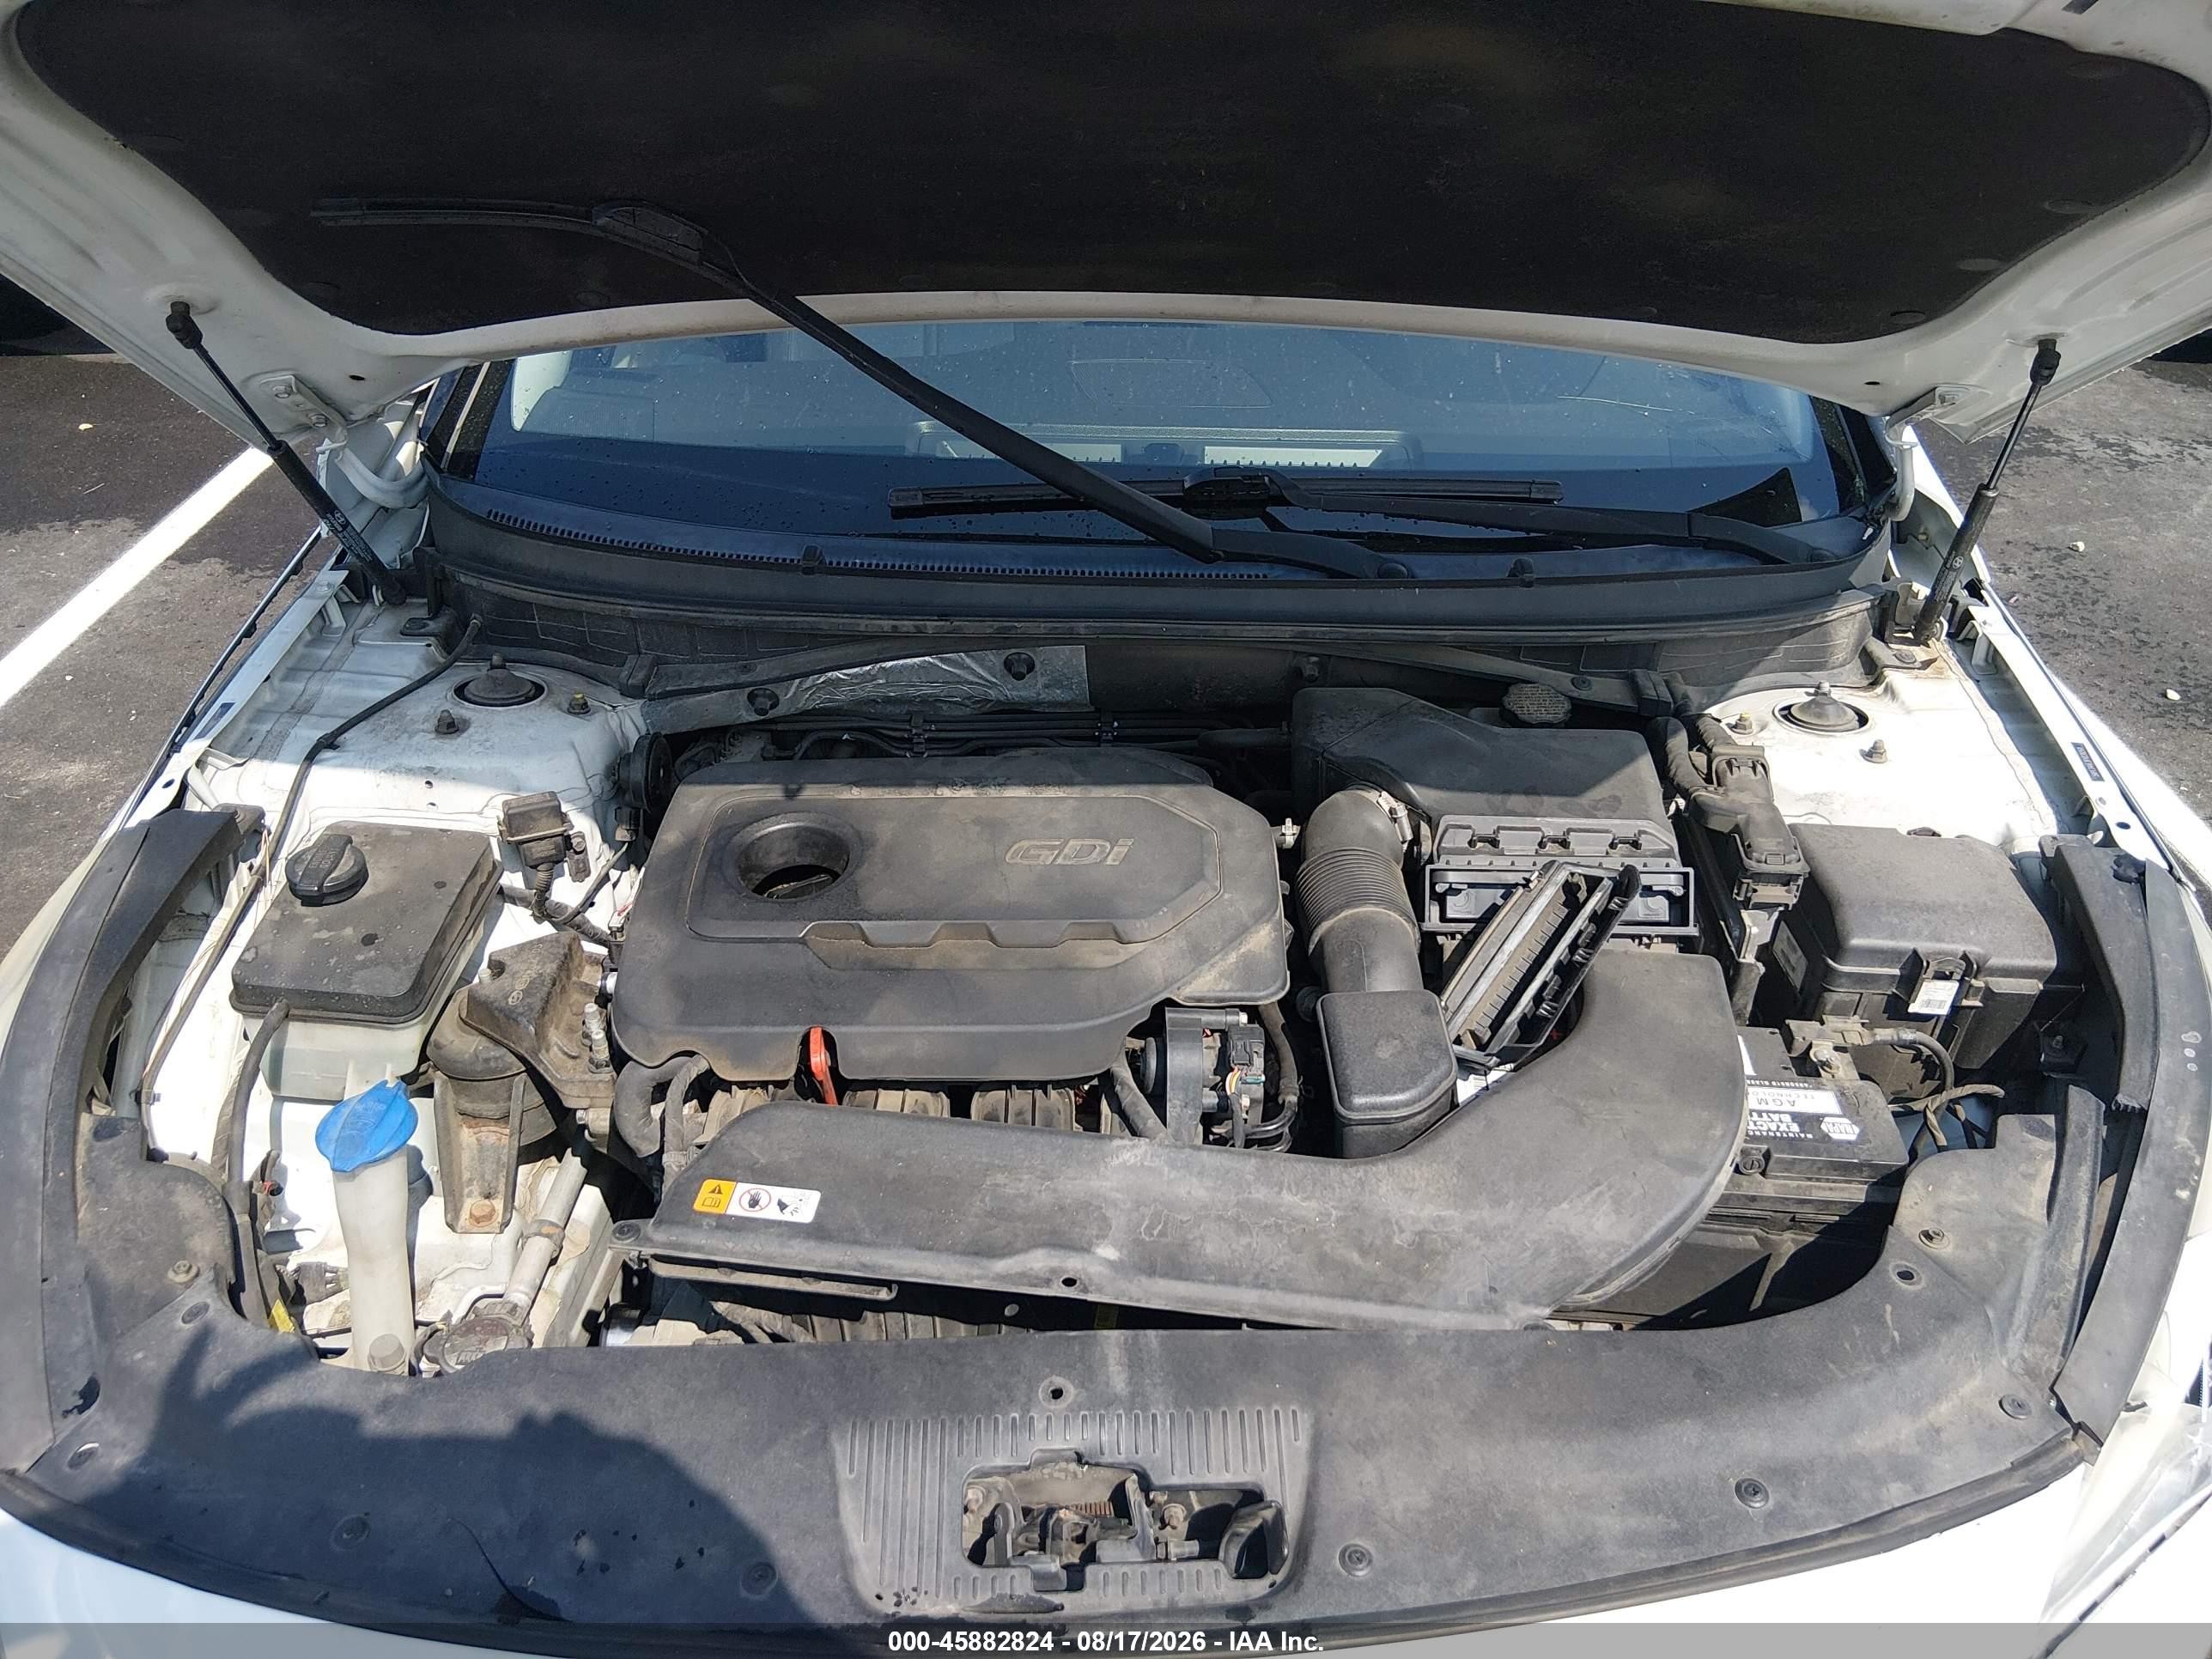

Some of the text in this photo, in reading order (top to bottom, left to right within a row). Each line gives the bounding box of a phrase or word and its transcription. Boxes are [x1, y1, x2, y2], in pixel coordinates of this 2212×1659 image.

[1005, 838, 1134, 866] GDi
[1757, 1097, 1796, 1107] AGM
[1747, 1111, 1793, 1122] BATT
[1747, 1118, 1801, 1133] EXACT
